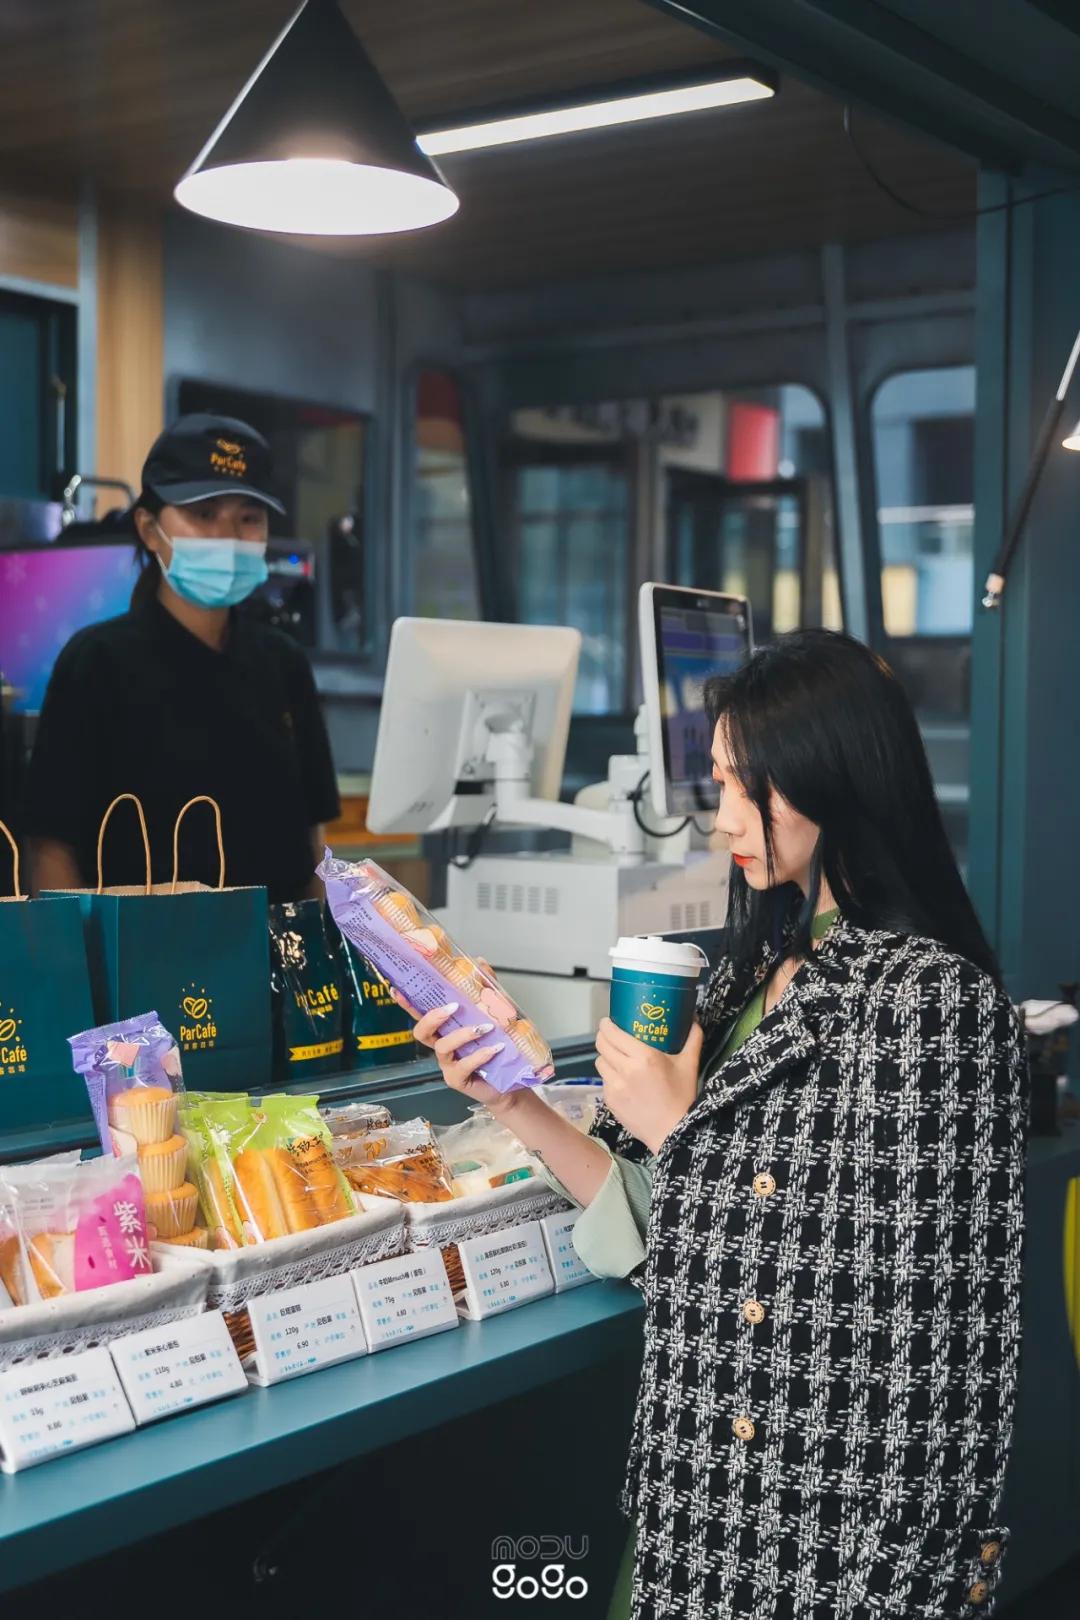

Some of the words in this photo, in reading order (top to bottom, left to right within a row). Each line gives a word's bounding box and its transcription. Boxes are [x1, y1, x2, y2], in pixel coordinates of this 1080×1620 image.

[180, 1022, 217, 1041] ParCafé
[633, 1020, 669, 1036] ParCafé
[0, 1045, 28, 1063] Café
[113, 1200, 152, 1270] 紫米
[385, 1296, 395, 1304] 75g
[285, 1326, 299, 1335] 120g
[297, 1340, 309, 1349] 6.90
[154, 1366, 170, 1375] 110g
